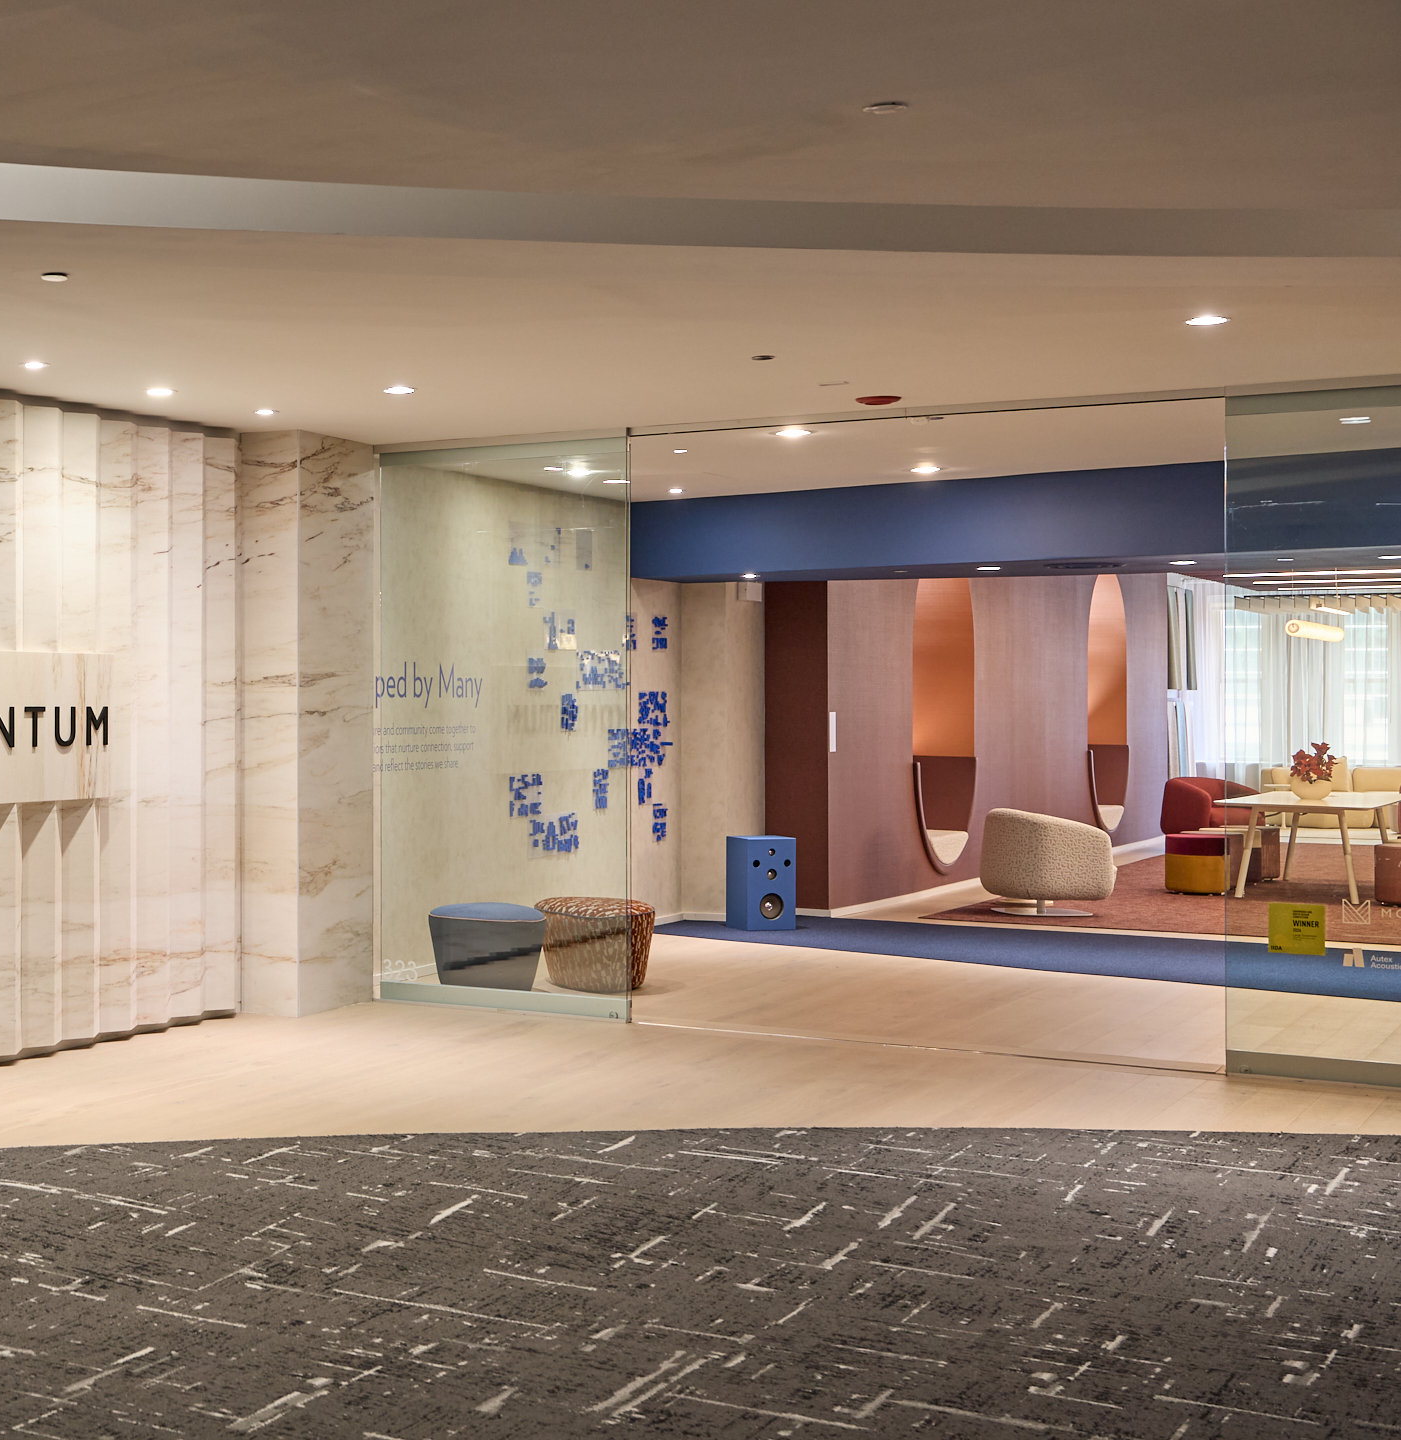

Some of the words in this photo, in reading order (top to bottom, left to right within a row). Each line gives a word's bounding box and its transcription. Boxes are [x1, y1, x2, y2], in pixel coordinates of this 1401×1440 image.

[375, 661, 407, 708] ped
[413, 661, 433, 708] by
[439, 662, 483, 708] Many
[383, 722, 395, 735] and
[395, 723, 429, 738] community
[428, 726, 445, 735] come
[445, 721, 469, 737] together
[469, 725, 476, 734] to
[385, 740, 397, 754] that
[398, 743, 419, 753] nurture
[453, 742, 474, 754] support
[384, 757, 404, 771] reflect
[404, 757, 414, 771] the
[415, 758, 434, 770] stories
[435, 761, 443, 769] we
[1292, 919, 1320, 928] WINNER
[1370, 955, 1393, 963] Autex
[383, 958, 418, 982] 323
